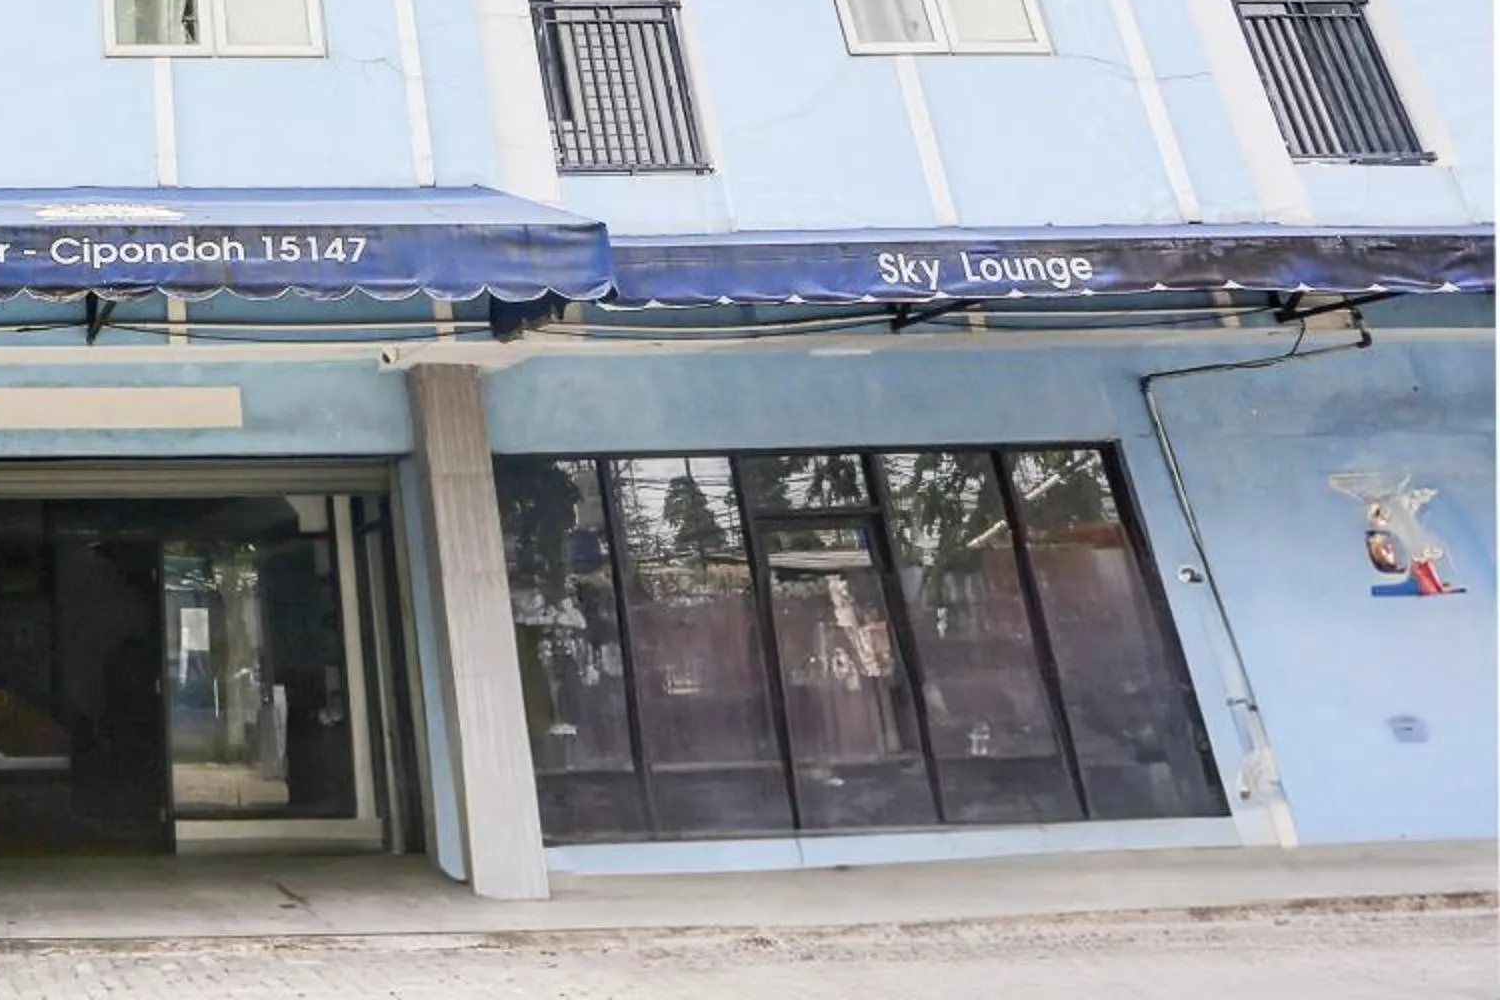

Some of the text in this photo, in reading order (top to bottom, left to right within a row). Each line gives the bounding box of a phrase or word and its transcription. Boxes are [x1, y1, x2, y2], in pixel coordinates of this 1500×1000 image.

[50, 236, 245, 268] Cipondoh
[261, 236, 367, 263] 15147
[878, 251, 1093, 290] Sky Lounge
